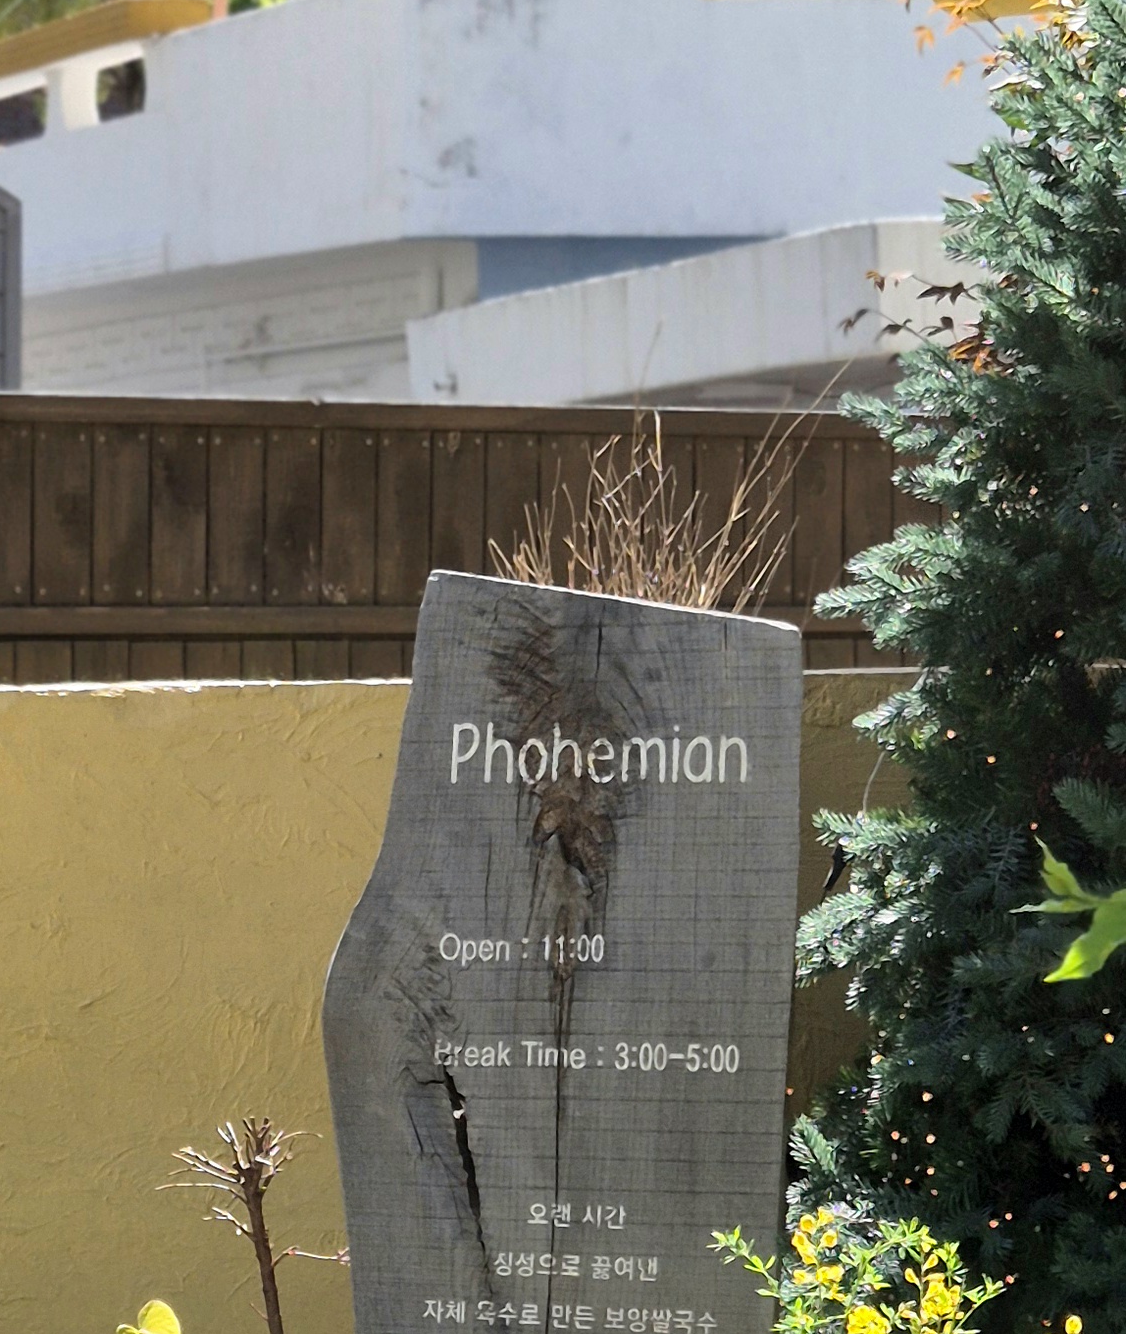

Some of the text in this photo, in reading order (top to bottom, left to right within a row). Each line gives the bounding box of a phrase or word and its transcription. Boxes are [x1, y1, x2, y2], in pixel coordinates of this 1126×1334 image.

[450, 722, 749, 784] Phohemian
[439, 933, 511, 966] Open
[542, 933, 606, 964] 11:00
[433, 1039, 512, 1068] Break
[520, 1040, 587, 1070] Time
[526, 1202, 627, 1230] 오랜 시간
[590, 1255, 659, 1283] 끓여낸
[422, 1299, 466, 1324] 자체
[551, 1303, 596, 1330] 만든
